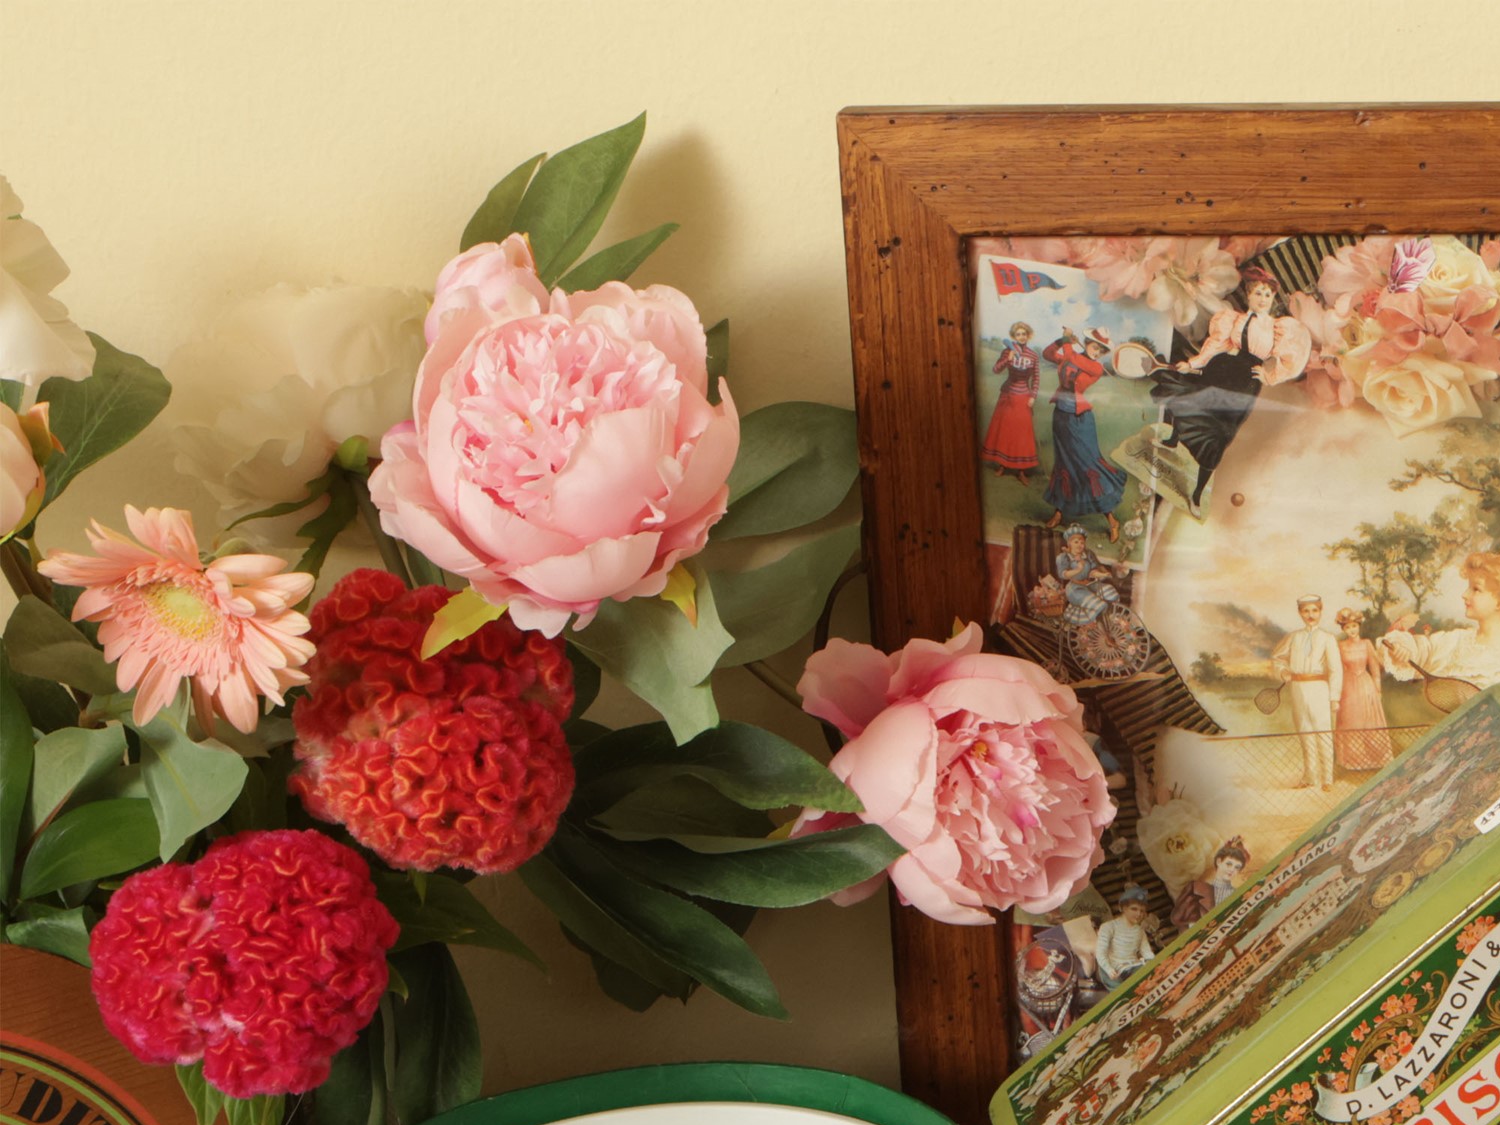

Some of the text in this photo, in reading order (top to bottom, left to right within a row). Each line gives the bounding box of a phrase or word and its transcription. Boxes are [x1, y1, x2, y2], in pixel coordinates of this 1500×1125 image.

[1117, 836, 1337, 1027] STABILIMENTO ANGLO-ITALIANO
[1345, 1097, 1373, 1116] D.
[1381, 957, 1489, 1101] LAZZARONI
